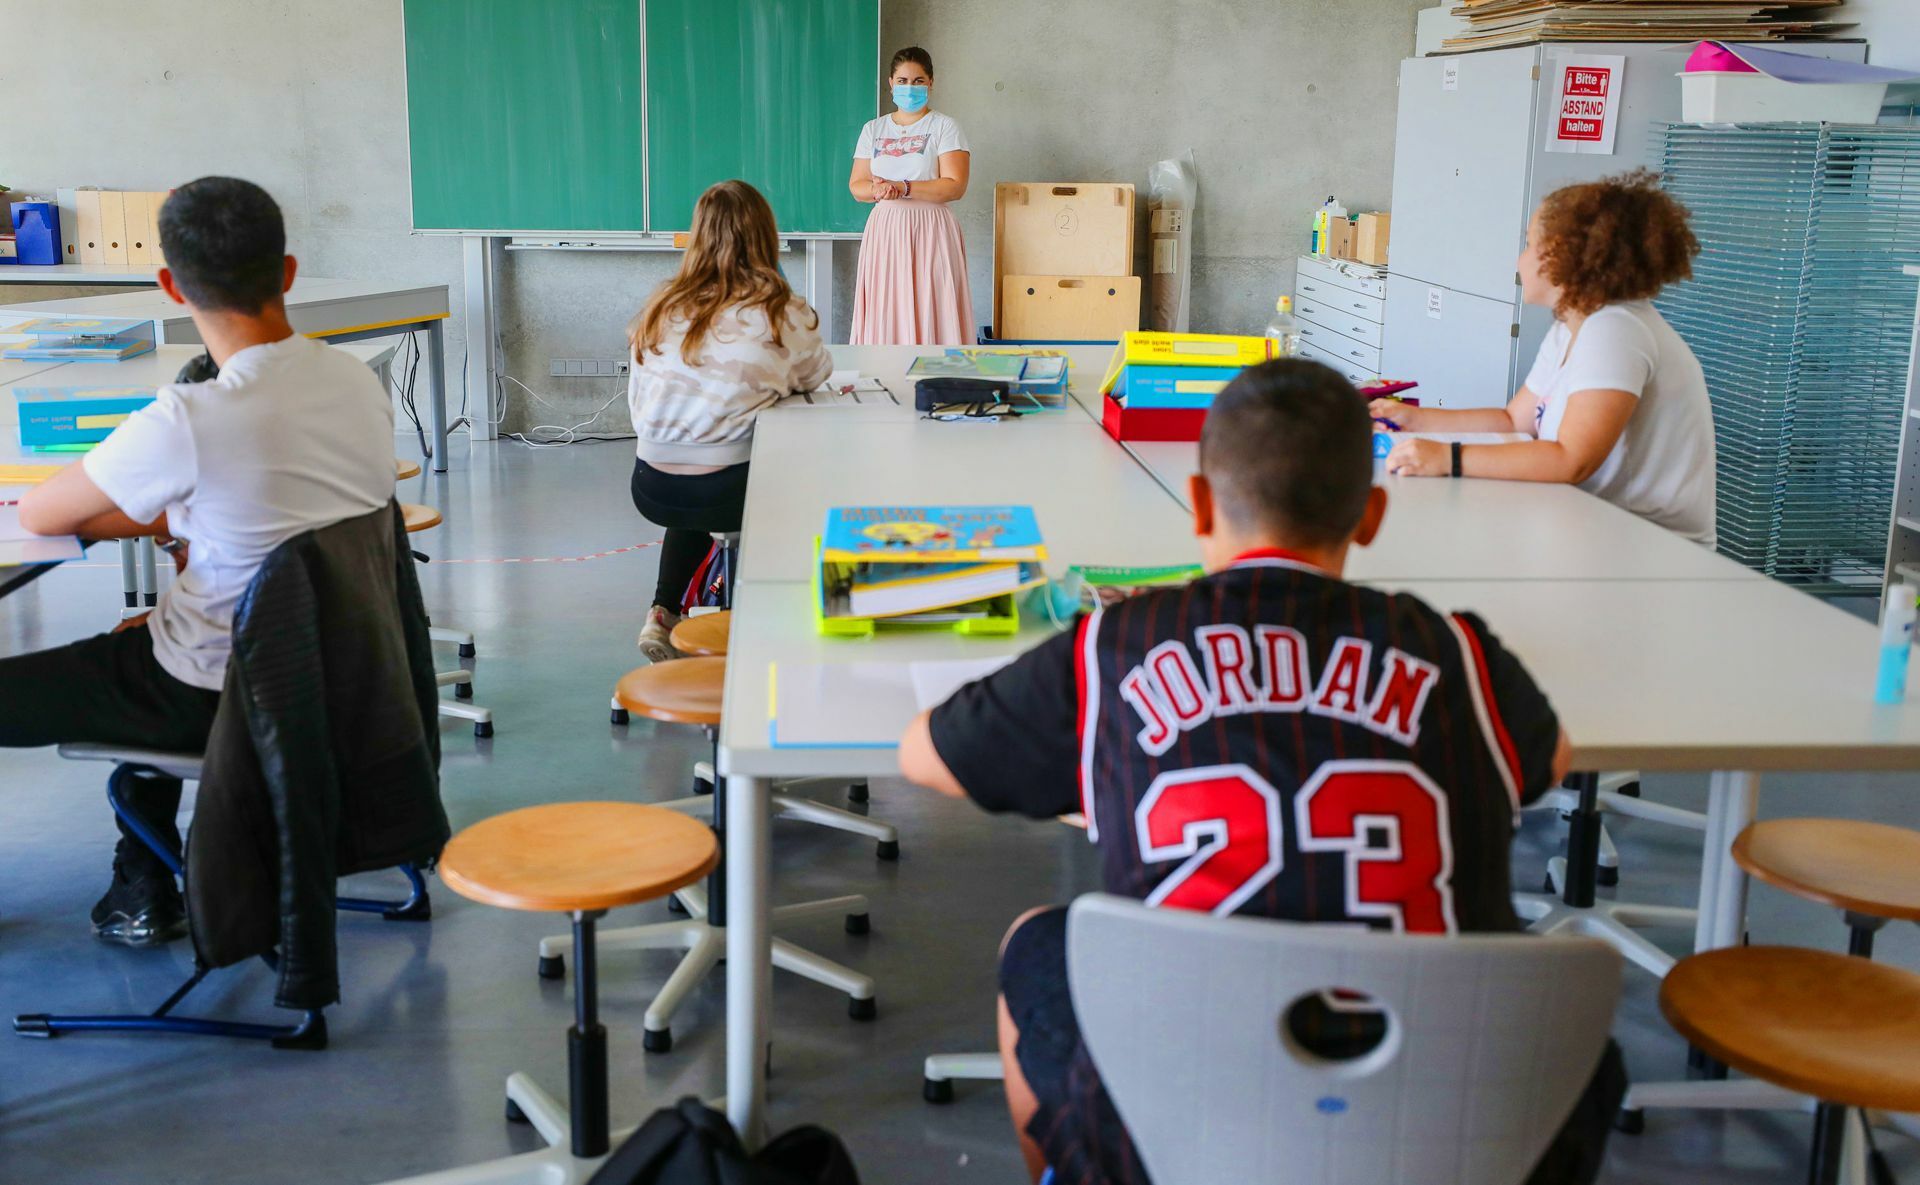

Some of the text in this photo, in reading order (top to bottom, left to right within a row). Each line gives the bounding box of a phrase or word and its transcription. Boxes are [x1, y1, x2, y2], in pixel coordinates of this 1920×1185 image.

[1575, 72, 1598, 85] Bitte
[1562, 100, 1604, 116] ABSTAND
[1566, 120, 1595, 133] halten
[1119, 624, 1440, 756] JORDAN
[1135, 759, 1458, 936] 23
